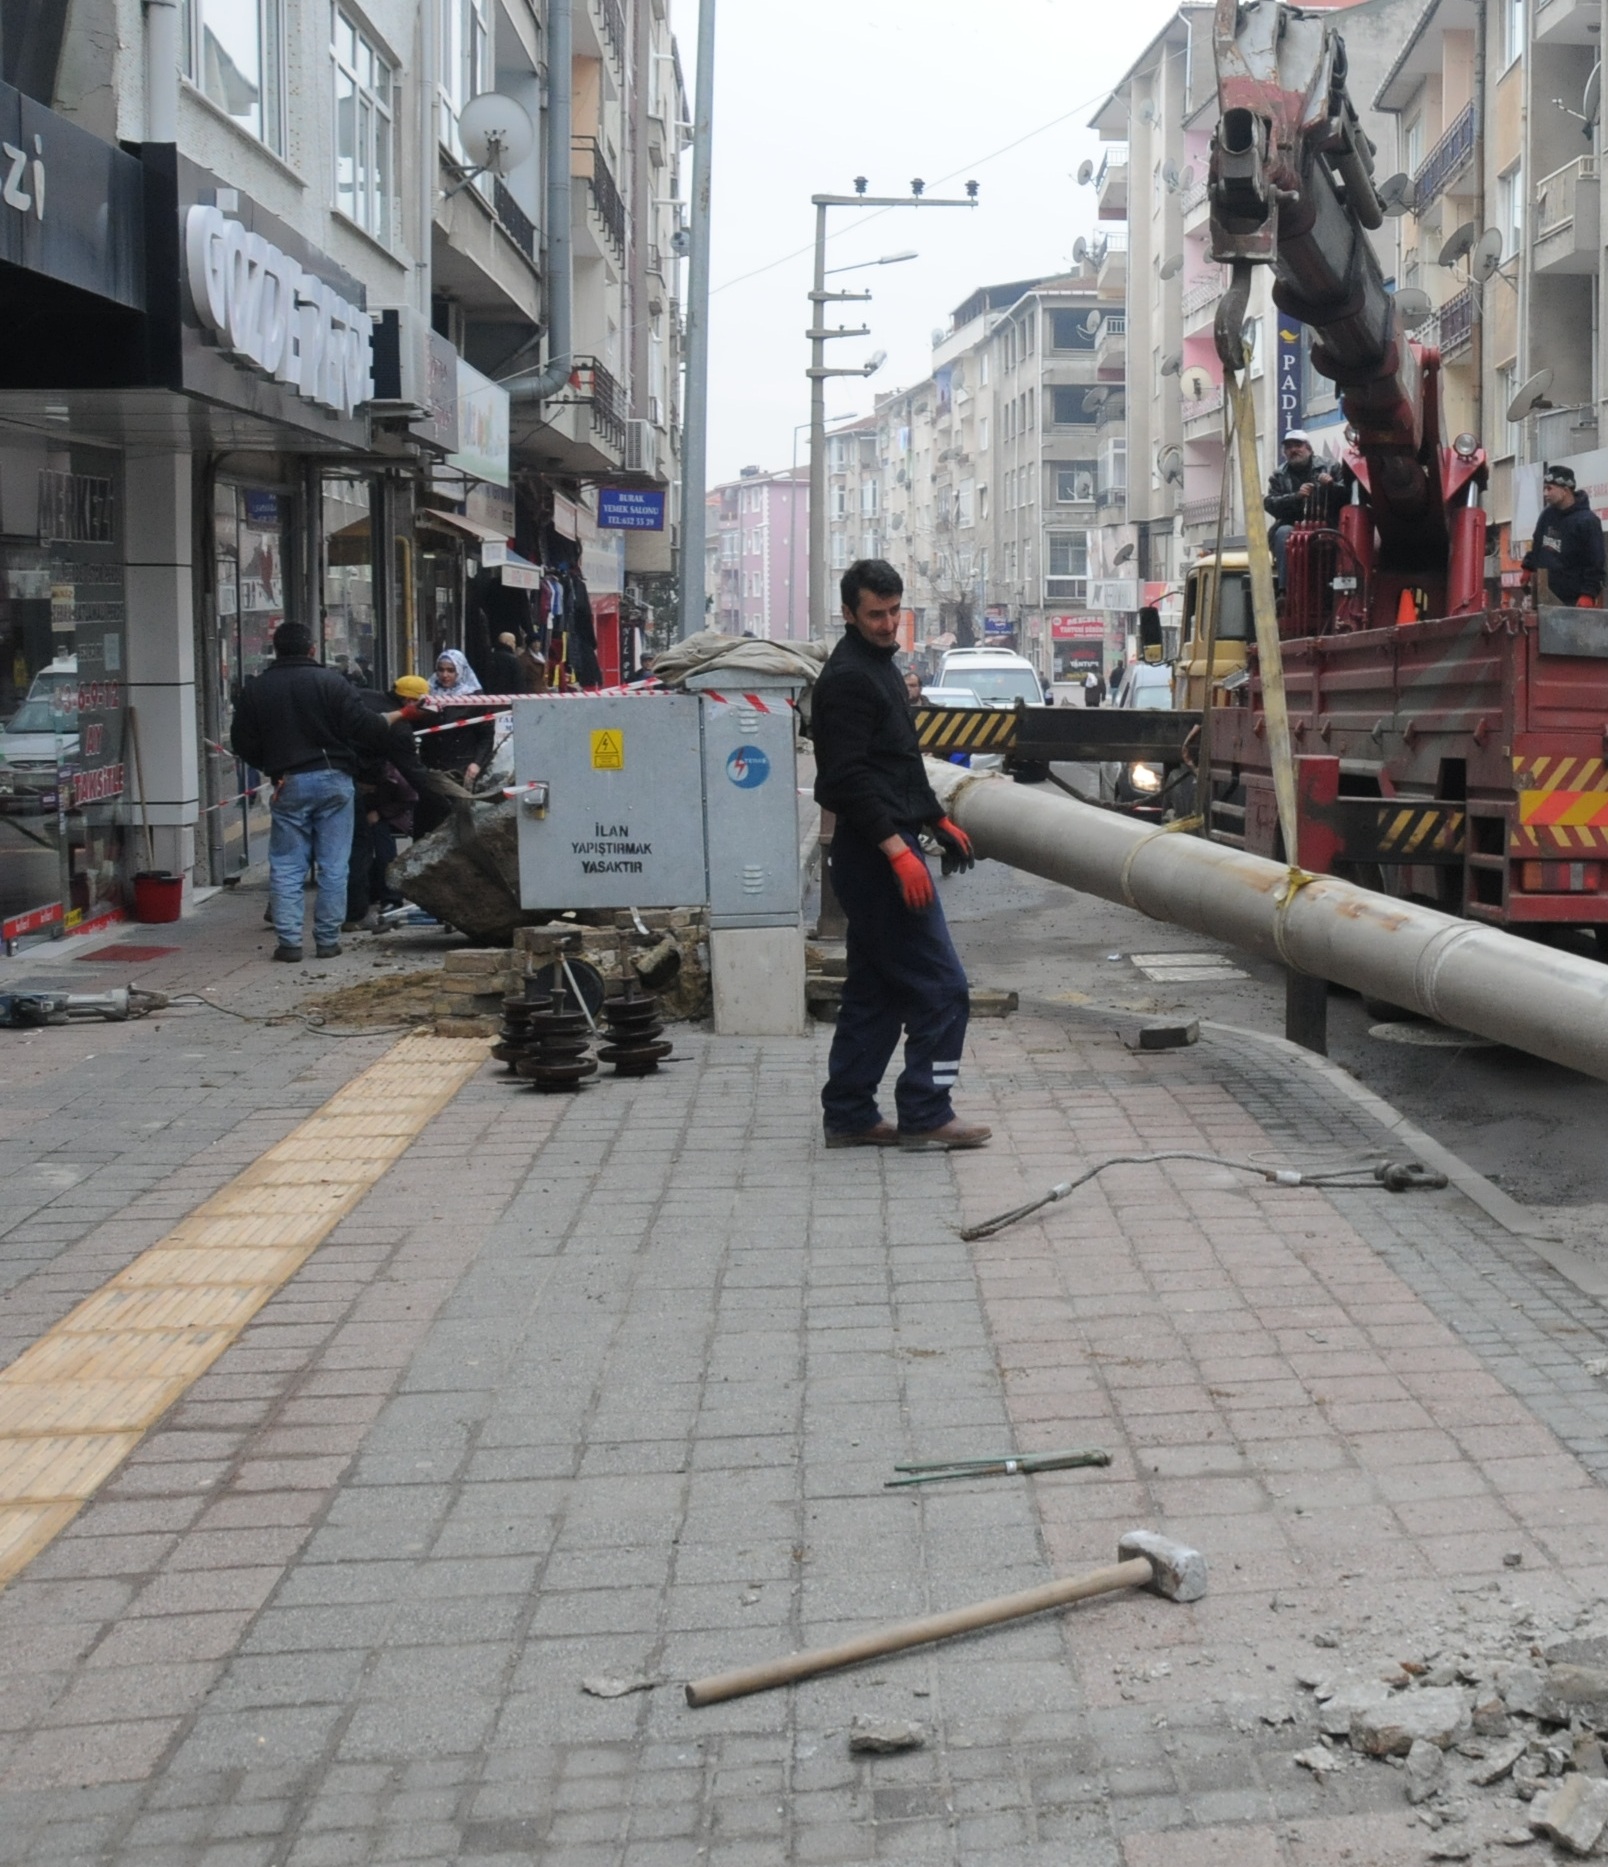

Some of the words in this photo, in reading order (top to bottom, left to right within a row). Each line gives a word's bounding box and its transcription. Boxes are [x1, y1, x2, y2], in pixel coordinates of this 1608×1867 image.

[603, 504, 628, 513] YEMEK
[630, 505, 659, 515] SALONU
[595, 822, 629, 837] İLAN
[572, 842, 652, 856] YAPIŞTIRMAK
[582, 861, 642, 874] YASAKTIR
